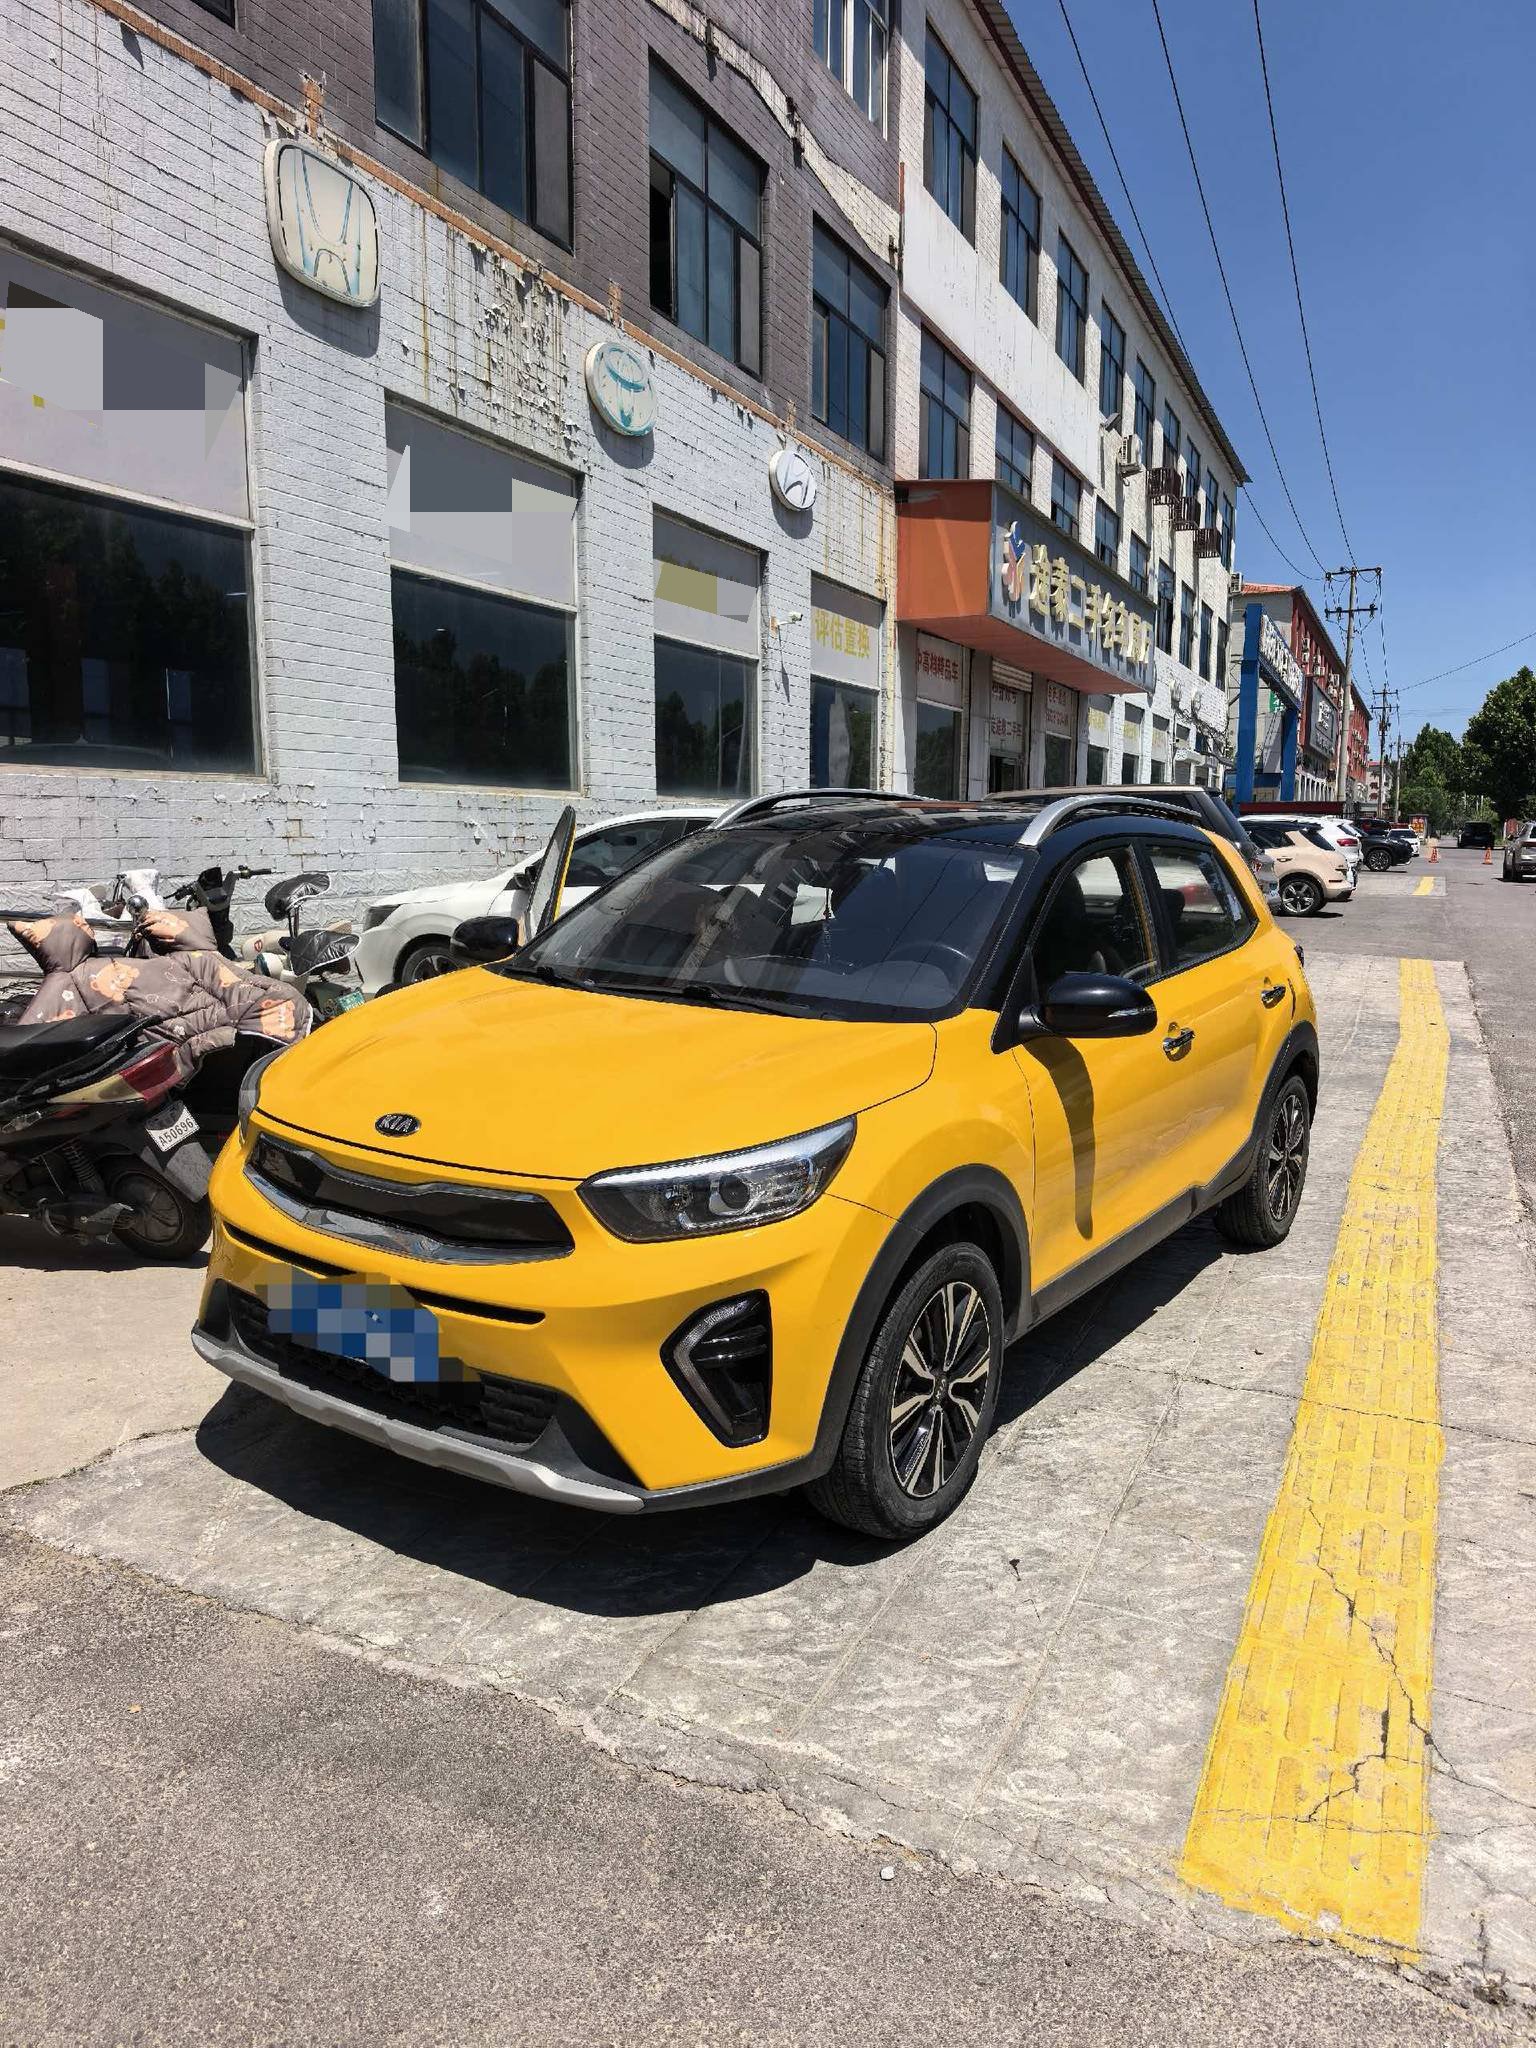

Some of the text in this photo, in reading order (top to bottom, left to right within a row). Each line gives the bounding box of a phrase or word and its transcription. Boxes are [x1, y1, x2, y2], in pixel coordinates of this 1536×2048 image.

[814, 608, 871, 659] 评估置换
[158, 1117, 194, 1147] A50696
[378, 1114, 413, 1133] KIA
